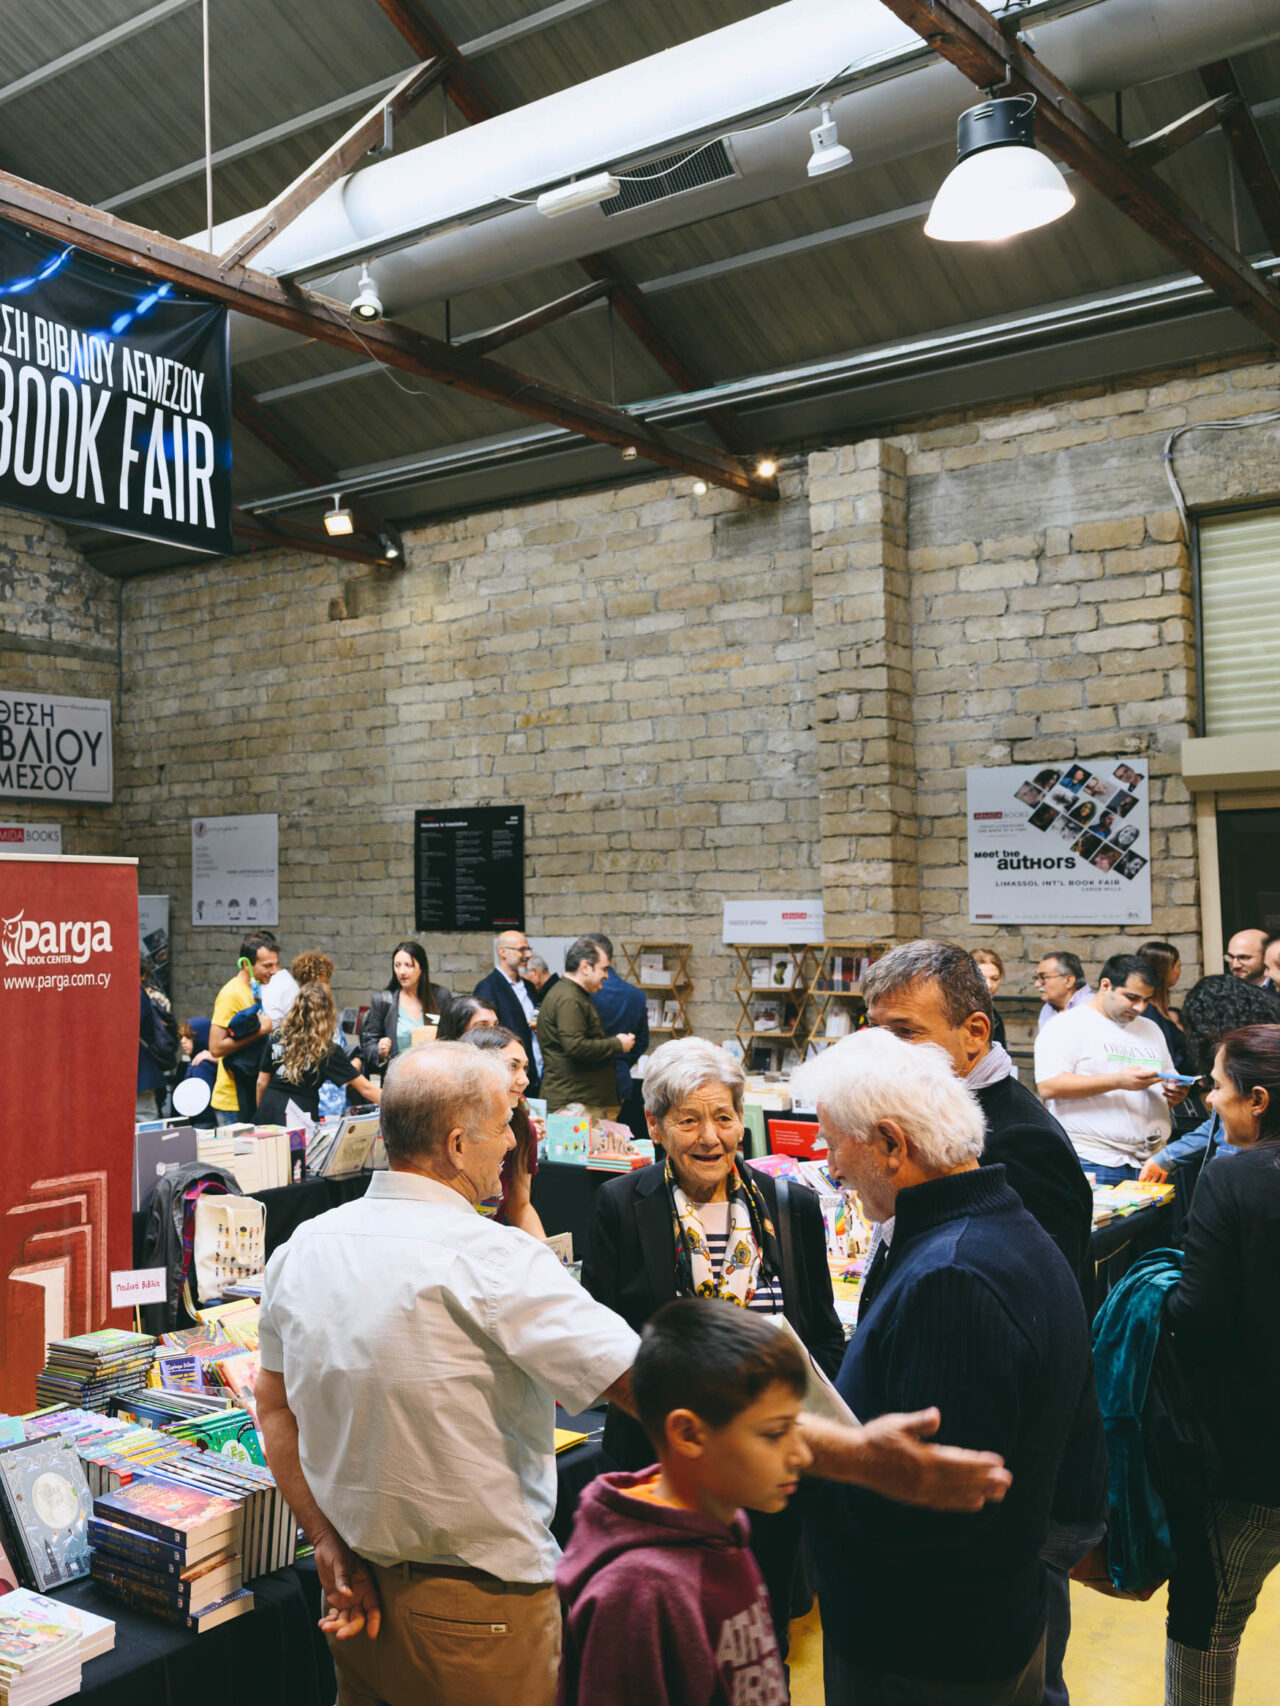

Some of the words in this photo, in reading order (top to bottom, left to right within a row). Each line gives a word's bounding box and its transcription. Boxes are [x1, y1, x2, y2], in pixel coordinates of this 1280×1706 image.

[35, 313, 115, 391] ΒΙΒΛΙΟΥ
[122, 346, 205, 416] ΛΕΜΕΣΟΥ
[120, 398, 216, 530] FAIR
[26, 830, 60, 842] BOOKS
[21, 920, 113, 964] parga
[27, 956, 46, 965] BOOK
[46, 955, 72, 964] CENTER
[3, 972, 112, 992] www.parga.com.cy
